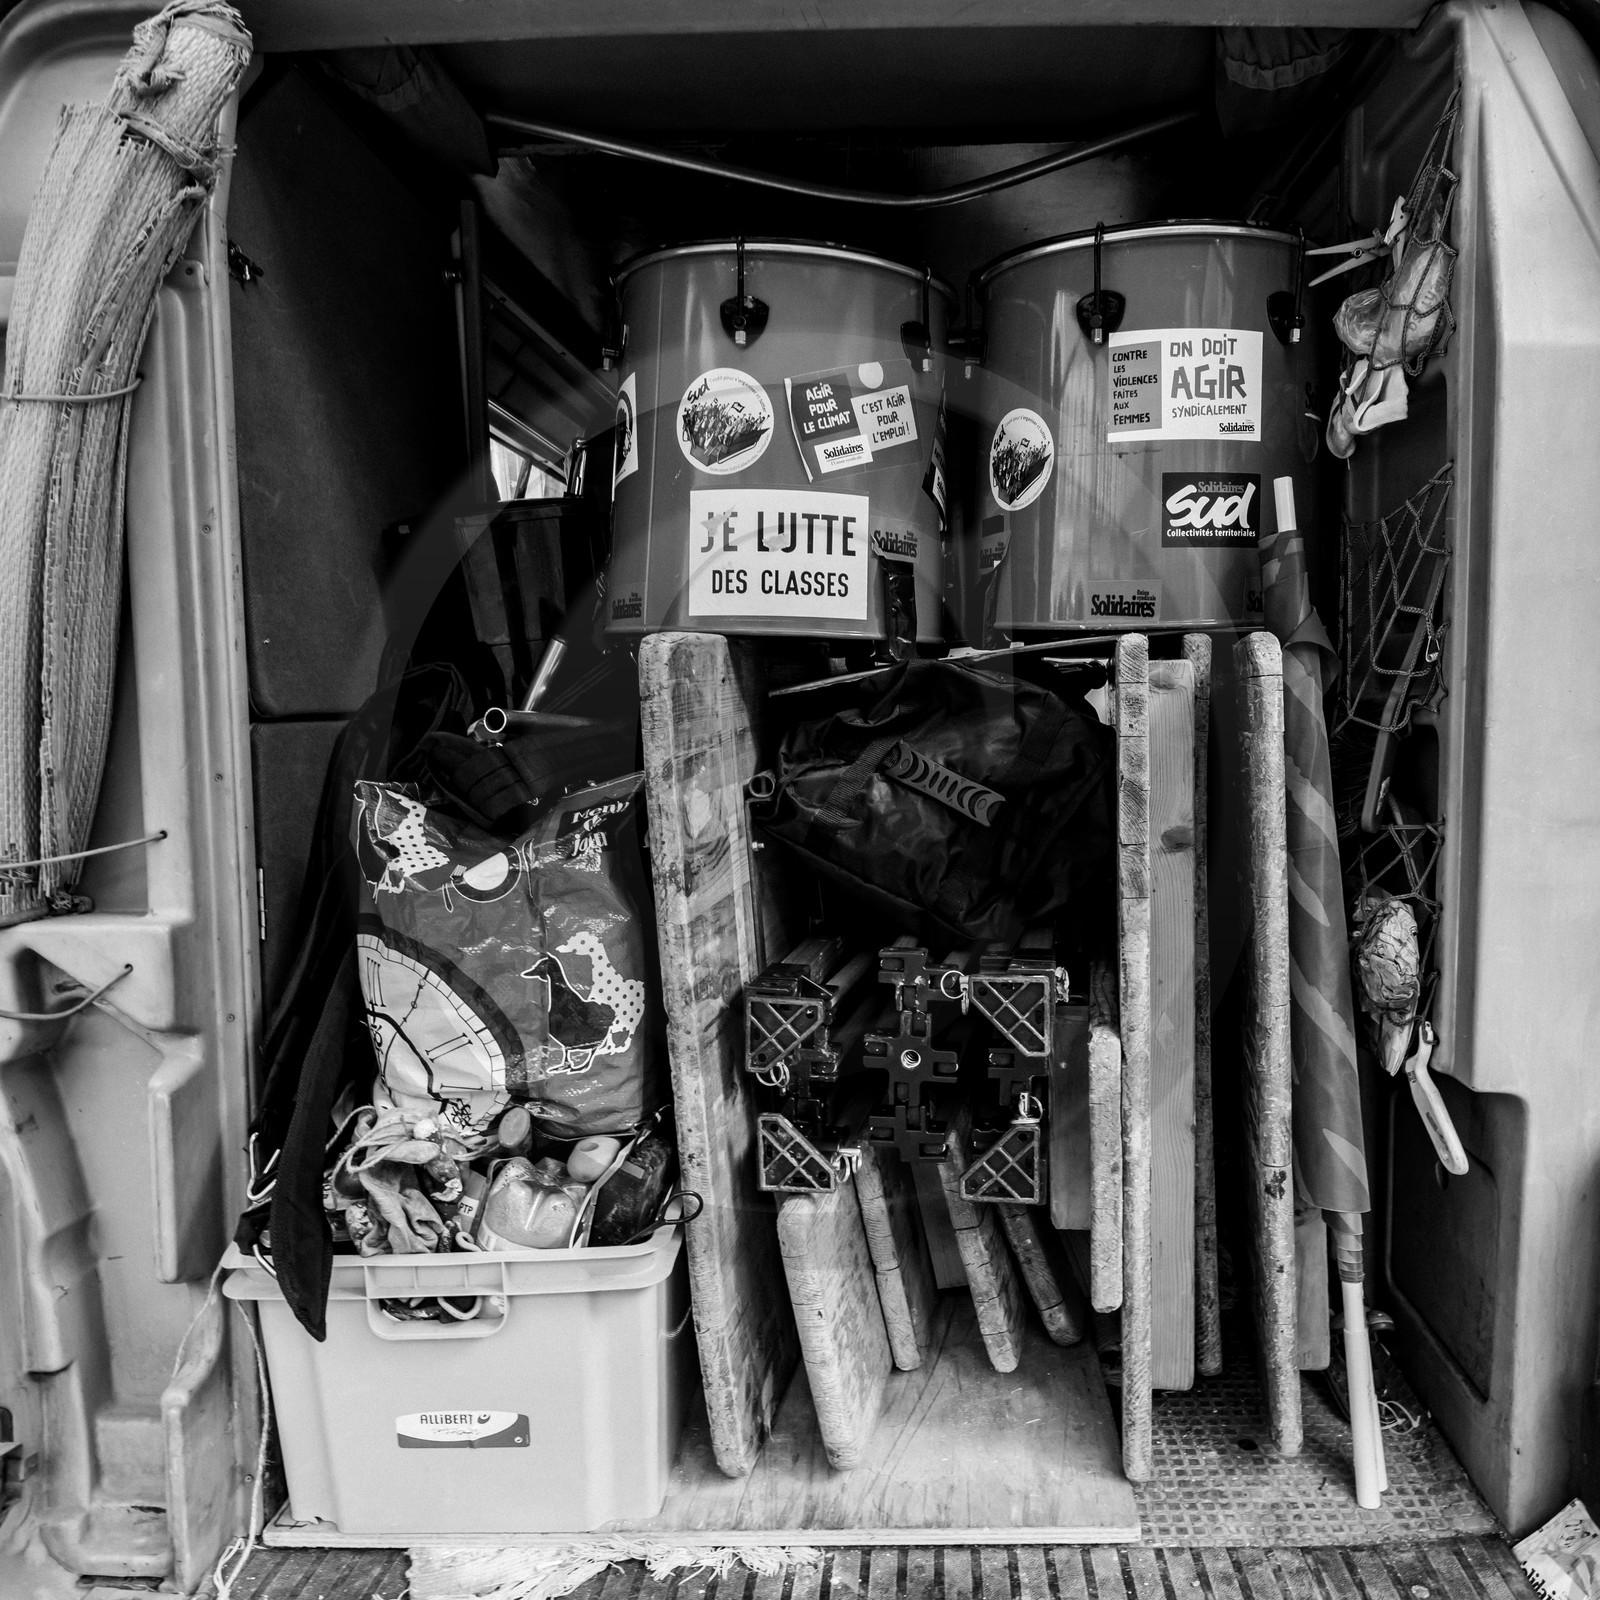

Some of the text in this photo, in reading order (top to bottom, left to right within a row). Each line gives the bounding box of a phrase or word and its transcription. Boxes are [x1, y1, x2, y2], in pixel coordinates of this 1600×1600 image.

[1112, 349, 1148, 362] CONTRE
[1170, 340, 1193, 358] ON
[1113, 365, 1126, 374] LES
[687, 377, 710, 404] Sud
[808, 398, 839, 416] POUR
[861, 399, 883, 415] C'EST
[1113, 401, 1130, 411] AUX
[876, 411, 900, 427] POUR
[1113, 412, 1151, 426] FEMMES
[1218, 421, 1256, 433] Solidaires
[803, 421, 816, 434] LE
[823, 442, 864, 460] Solidaires
[1197, 481, 1245, 493] Solidaires
[1165, 481, 1257, 529] Sud
[700, 511, 857, 556] JE LUTTE
[1166, 528, 1256, 537] Collectivités territoriales
[873, 529, 918, 558] Solidaires
[711, 569, 849, 597] DES CLASSES
[1090, 594, 1156, 618] Solidaires
